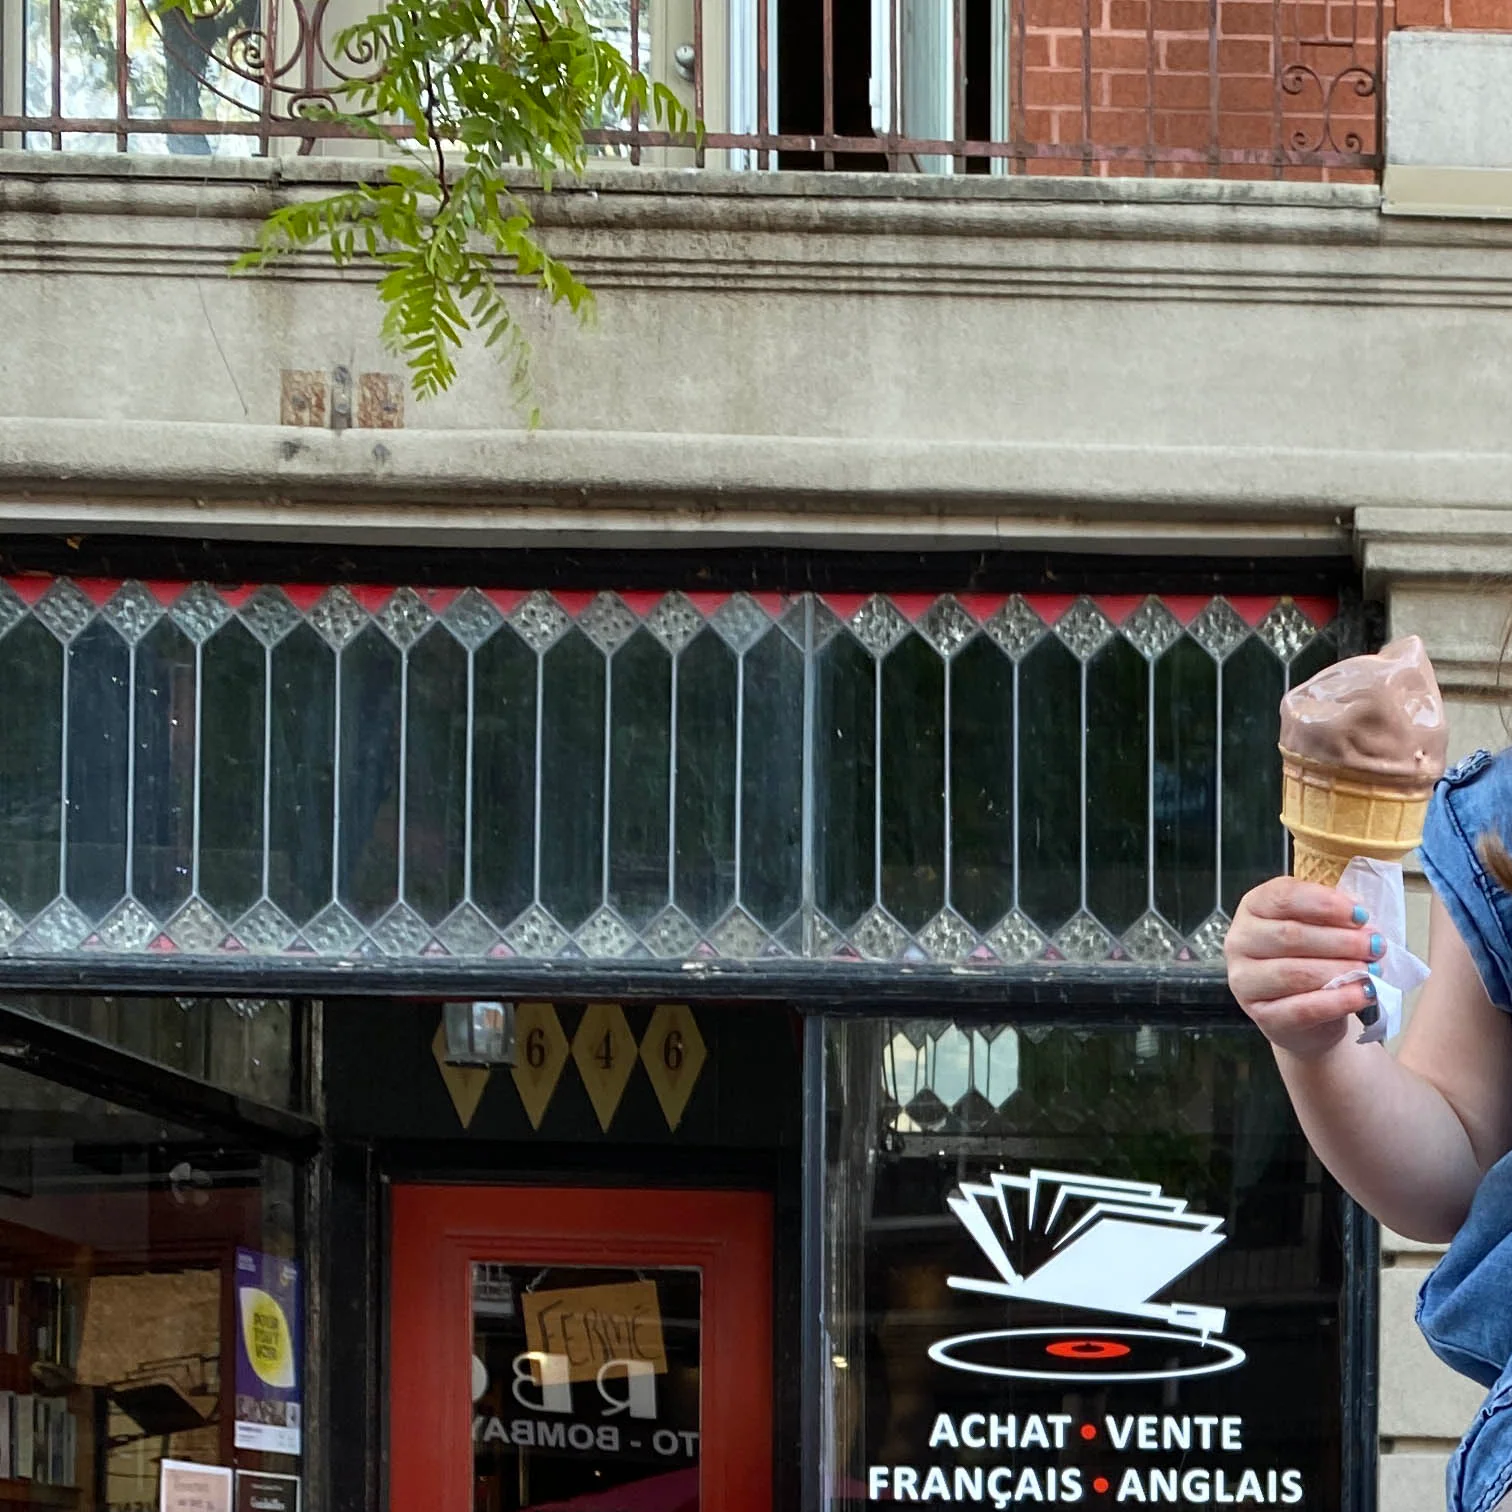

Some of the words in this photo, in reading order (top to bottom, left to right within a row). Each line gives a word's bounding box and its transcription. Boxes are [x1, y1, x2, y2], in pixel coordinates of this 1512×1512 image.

[525, 1027, 684, 1071] 646
[929, 1414, 1071, 1448] ACHAT
[1106, 1416, 1241, 1449] VENTE
[870, 1467, 1082, 1509] FRANÇAIS
[1118, 1469, 1302, 1503] ANGLAIS
